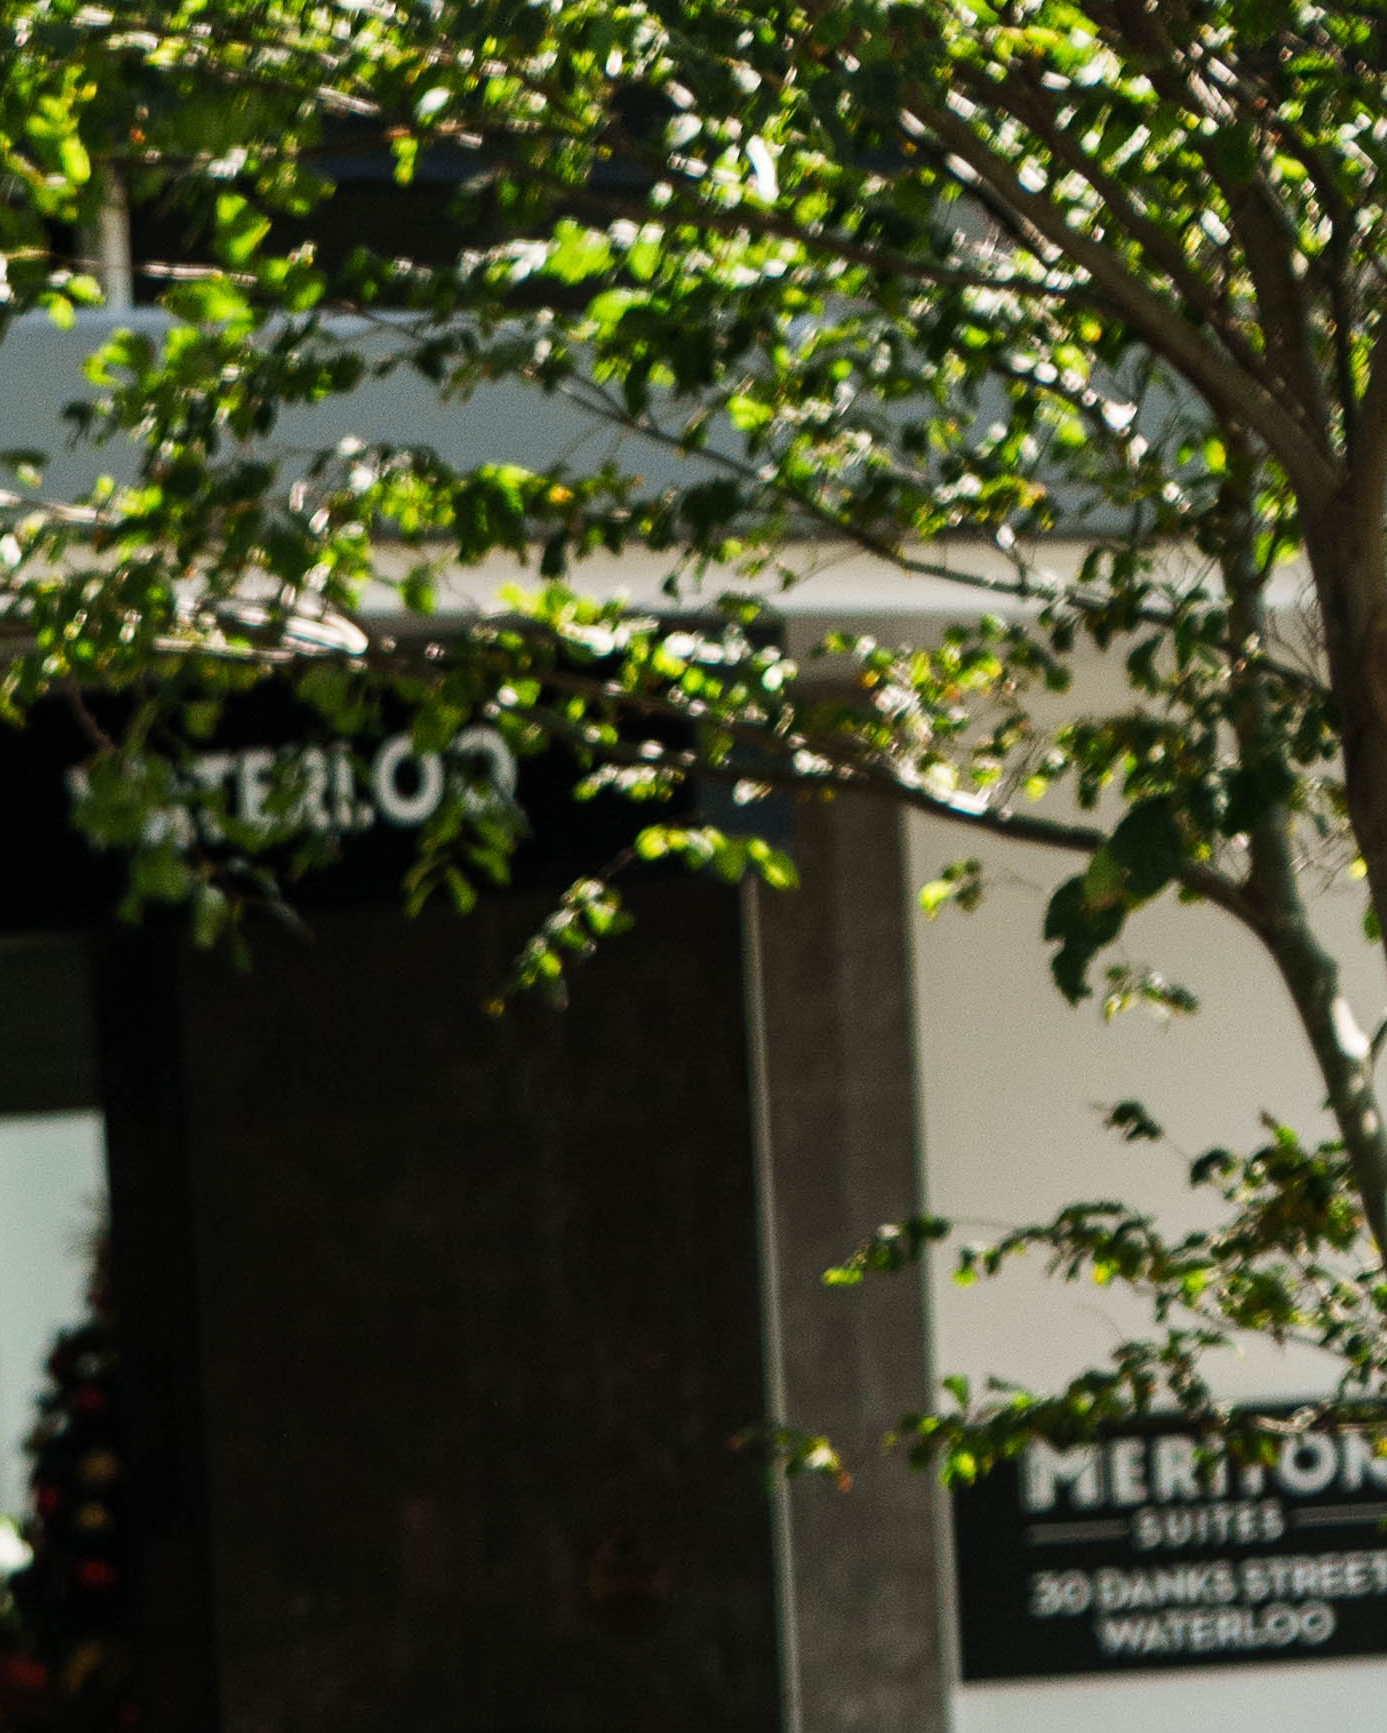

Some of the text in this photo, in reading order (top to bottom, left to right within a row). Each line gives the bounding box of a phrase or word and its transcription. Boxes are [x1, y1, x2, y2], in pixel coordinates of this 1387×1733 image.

[1134, 1499, 1286, 1551] SUITES
[1030, 1569, 1092, 1618] 30
[1096, 1558, 1237, 1610] DANKS
[1094, 1599, 1337, 1657] WATERLOO
